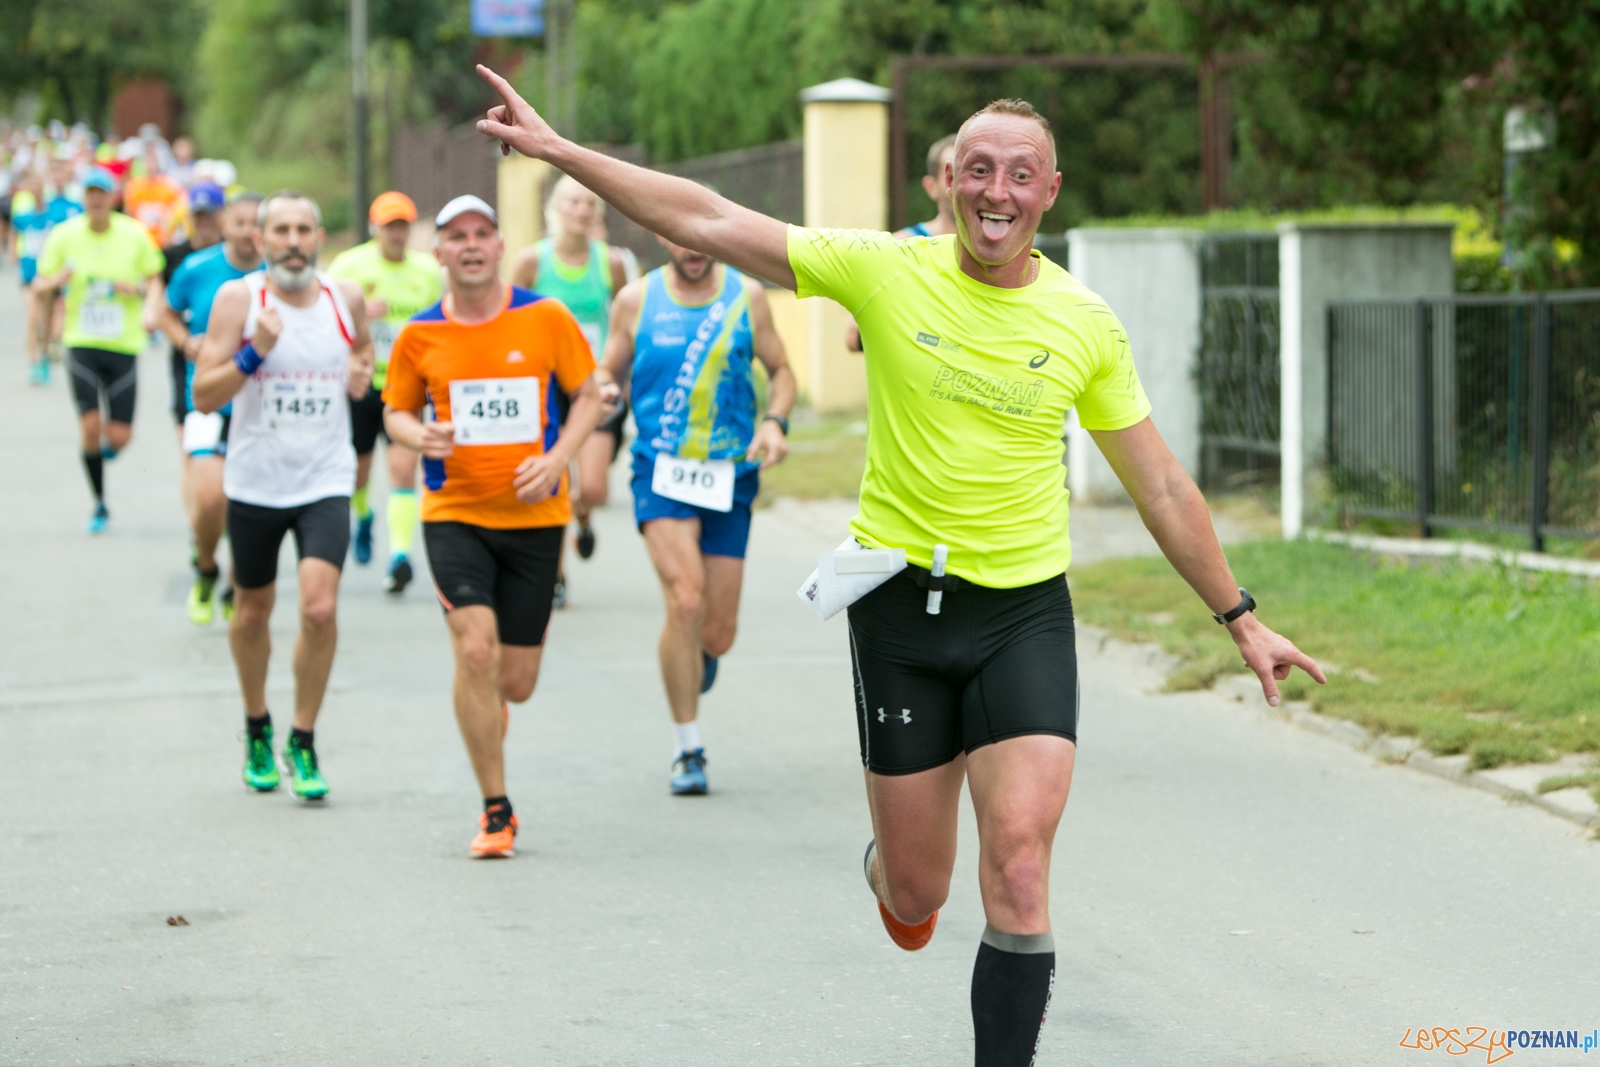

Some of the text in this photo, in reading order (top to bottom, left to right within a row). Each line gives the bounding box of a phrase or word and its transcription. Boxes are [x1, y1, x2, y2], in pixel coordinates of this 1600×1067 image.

[933, 364, 1044, 407] POZNAŃ
[272, 397, 331, 416] 1457
[470, 399, 519, 418] 458
[929, 389, 944, 400] IT'S
[944, 393, 950, 401] A
[952, 394, 966, 403] BIG
[967, 397, 989, 409] RACE.
[992, 402, 1004, 412] GO
[1005, 405, 1022, 416] RUN
[672, 466, 715, 488] 910
